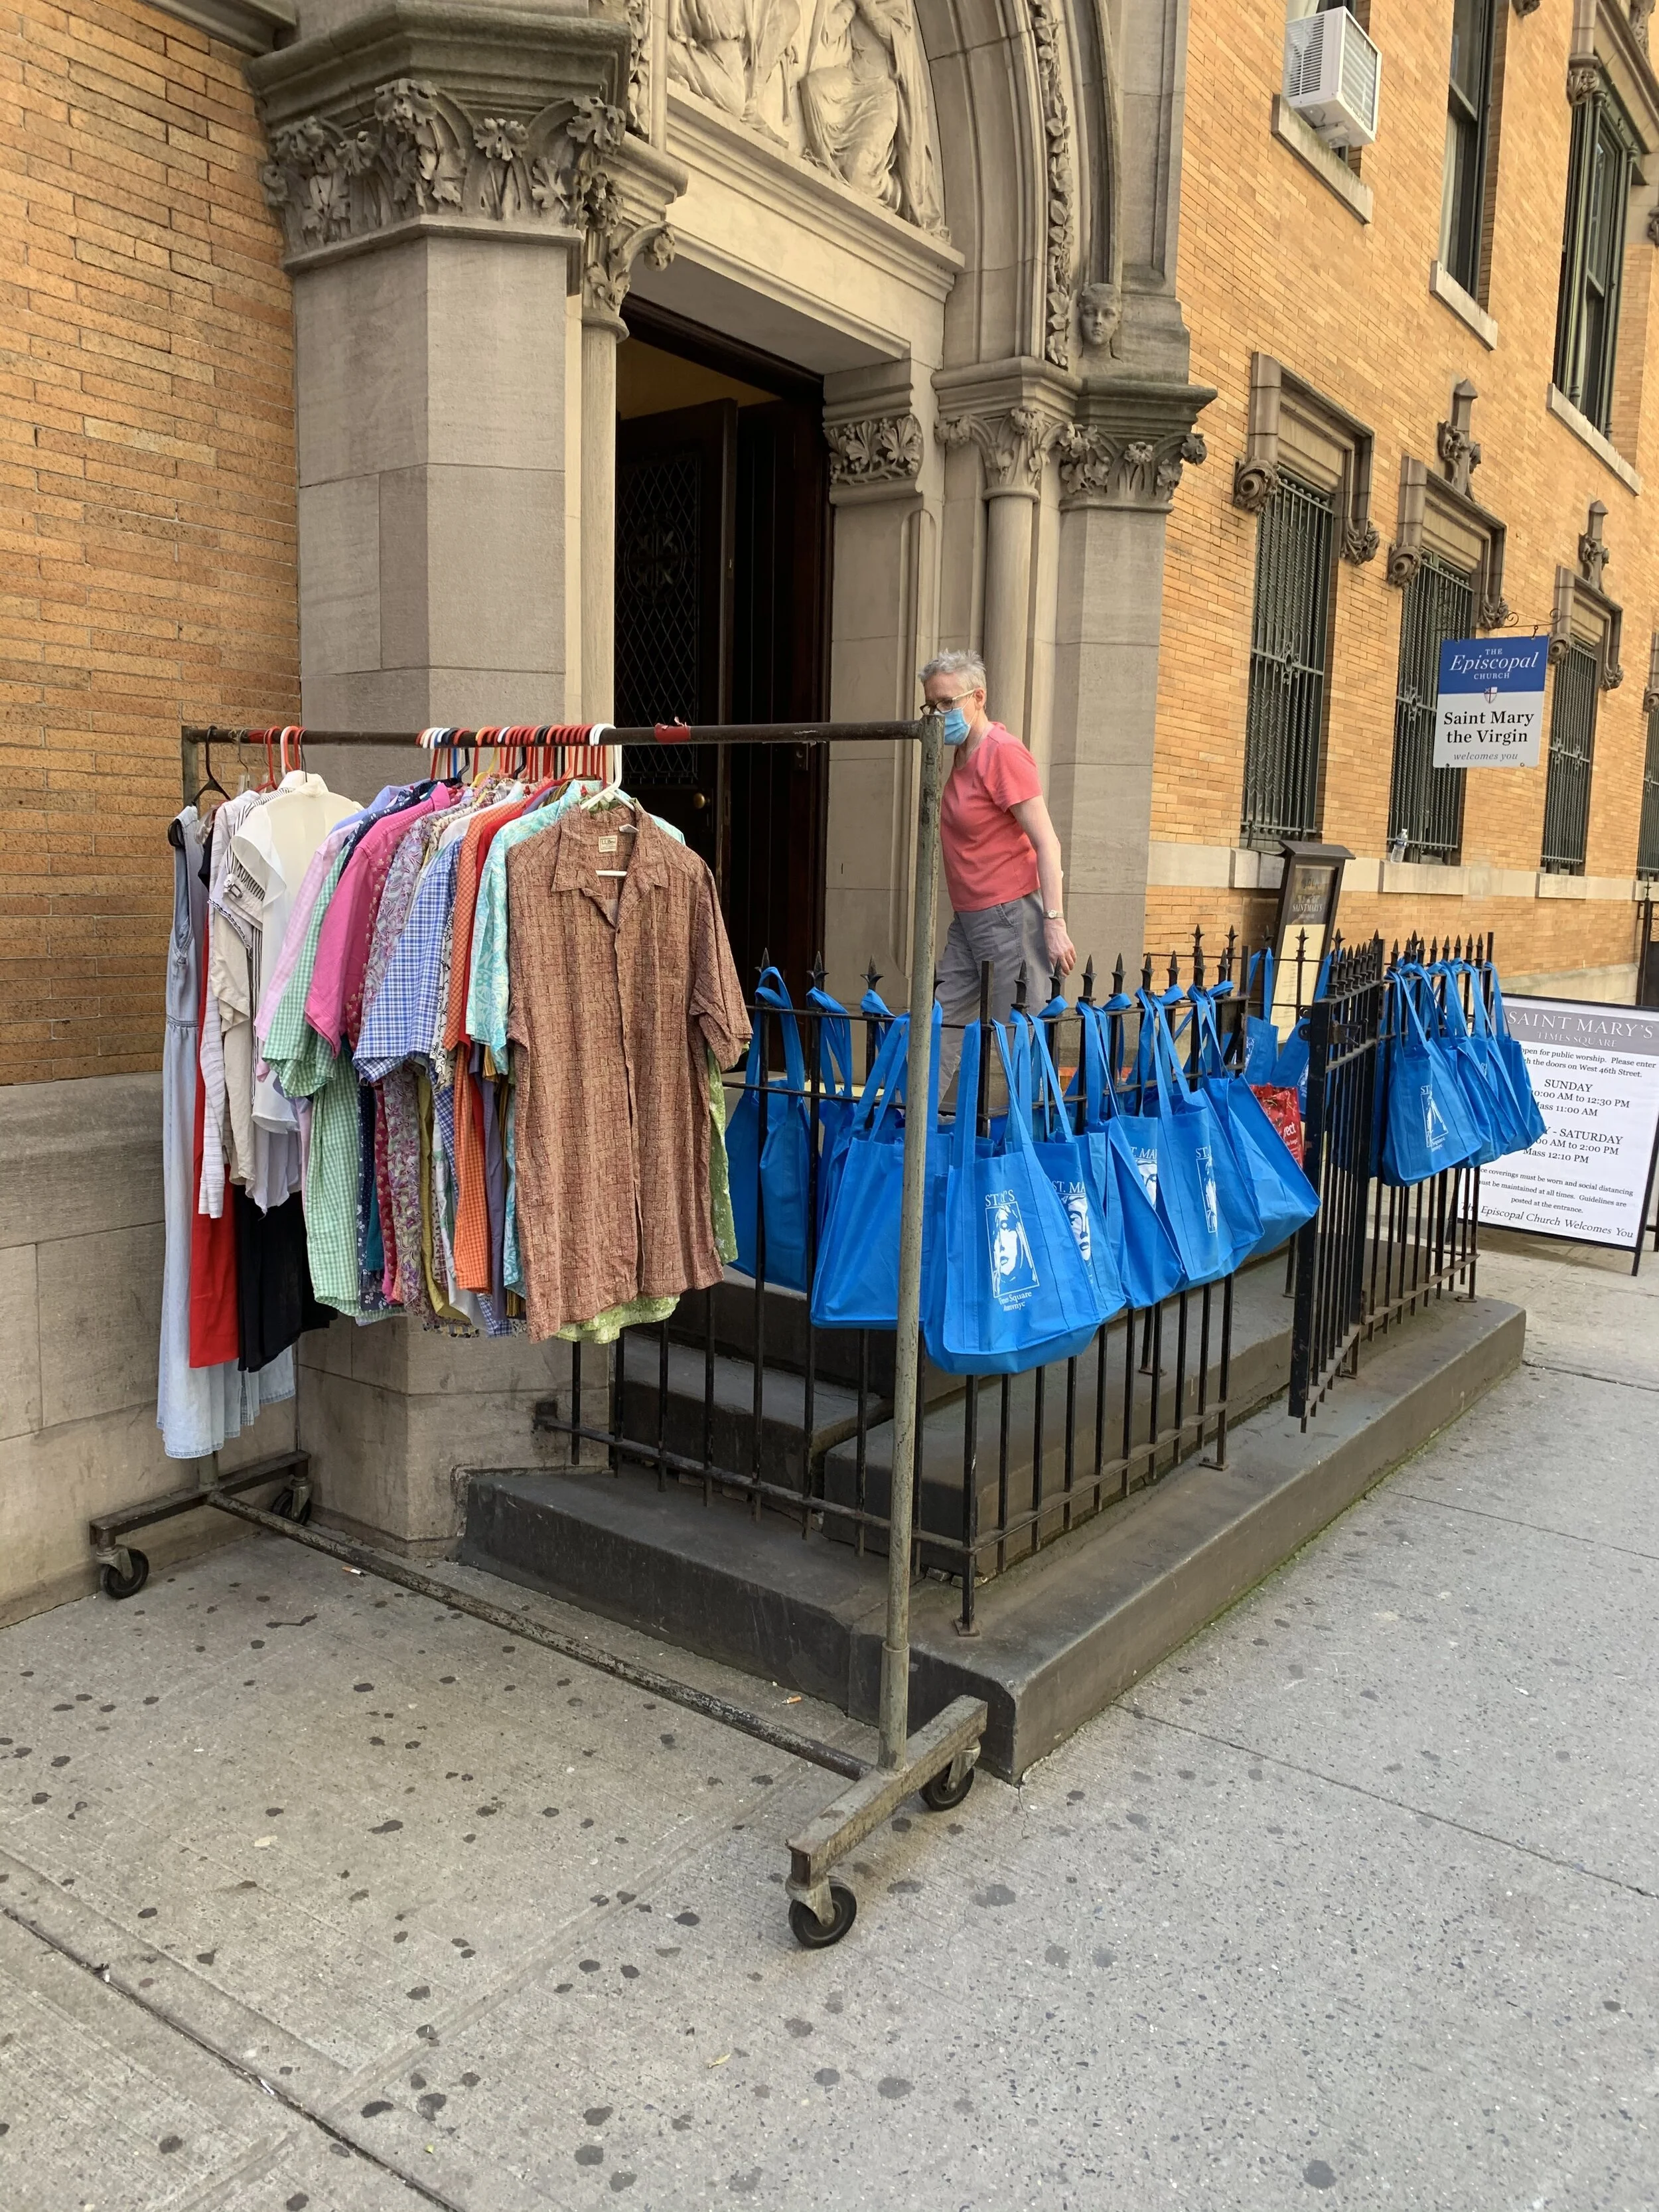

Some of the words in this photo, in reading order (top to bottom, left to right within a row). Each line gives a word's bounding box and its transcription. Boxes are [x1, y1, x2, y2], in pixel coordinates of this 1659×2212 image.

[1449, 652, 1540, 674] Episcopal
[1443, 711, 1486, 725] Saint
[1490, 711, 1534, 726] Mary
[1447, 730, 1472, 743] the
[1477, 729, 1528, 746] Virgin
[1500, 753, 1518, 762] you
[1507, 1011, 1572, 1030] SAINT
[1577, 1018, 1654, 1039] MARY'S
[1537, 1031, 1571, 1042] TIMES
[1573, 1036, 1618, 1047] SQUARE
[1551, 1050, 1574, 1059] public
[1575, 1054, 1607, 1063] worship.
[1611, 1057, 1634, 1066] Please
[1546, 1060, 1566, 1069] doors
[1579, 1064, 1597, 1072] West
[1618, 1069, 1642, 1078] Street.
[1544, 1078, 1593, 1092] SUNDAY
[1557, 1092, 1573, 1102] AM
[1587, 1097, 1612, 1107] 12:30
[1615, 1099, 1630, 1108] PM
[1555, 1106, 1579, 1114] 11:00
[1581, 1108, 1598, 1117] AM
[1559, 1128, 1624, 1145] SATURDAY
[1550, 1139, 1566, 1148] AM
[1579, 1144, 1601, 1153] 2:00
[1603, 1146, 1619, 1155] PM
[1523, 1148, 1546, 1157] Mass
[1548, 1152, 1571, 1161] 12:10
[1573, 1154, 1590, 1163] PM
[1488, 1169, 1519, 1179] coverings
[1599, 1185, 1634, 1197] distancing
[1501, 1183, 1538, 1193] maintained
[1556, 1191, 1575, 1199] times.
[1579, 1195, 1614, 1206] Guidelines
[1553, 1204, 1583, 1213] entrance.
[1480, 1205, 1525, 1220] Episcopal
[1526, 1213, 1561, 1226] Church
[1565, 1219, 1612, 1234] Welcomes
[1617, 1227, 1634, 1238] You
[1009, 1291, 1032, 1303] Square
